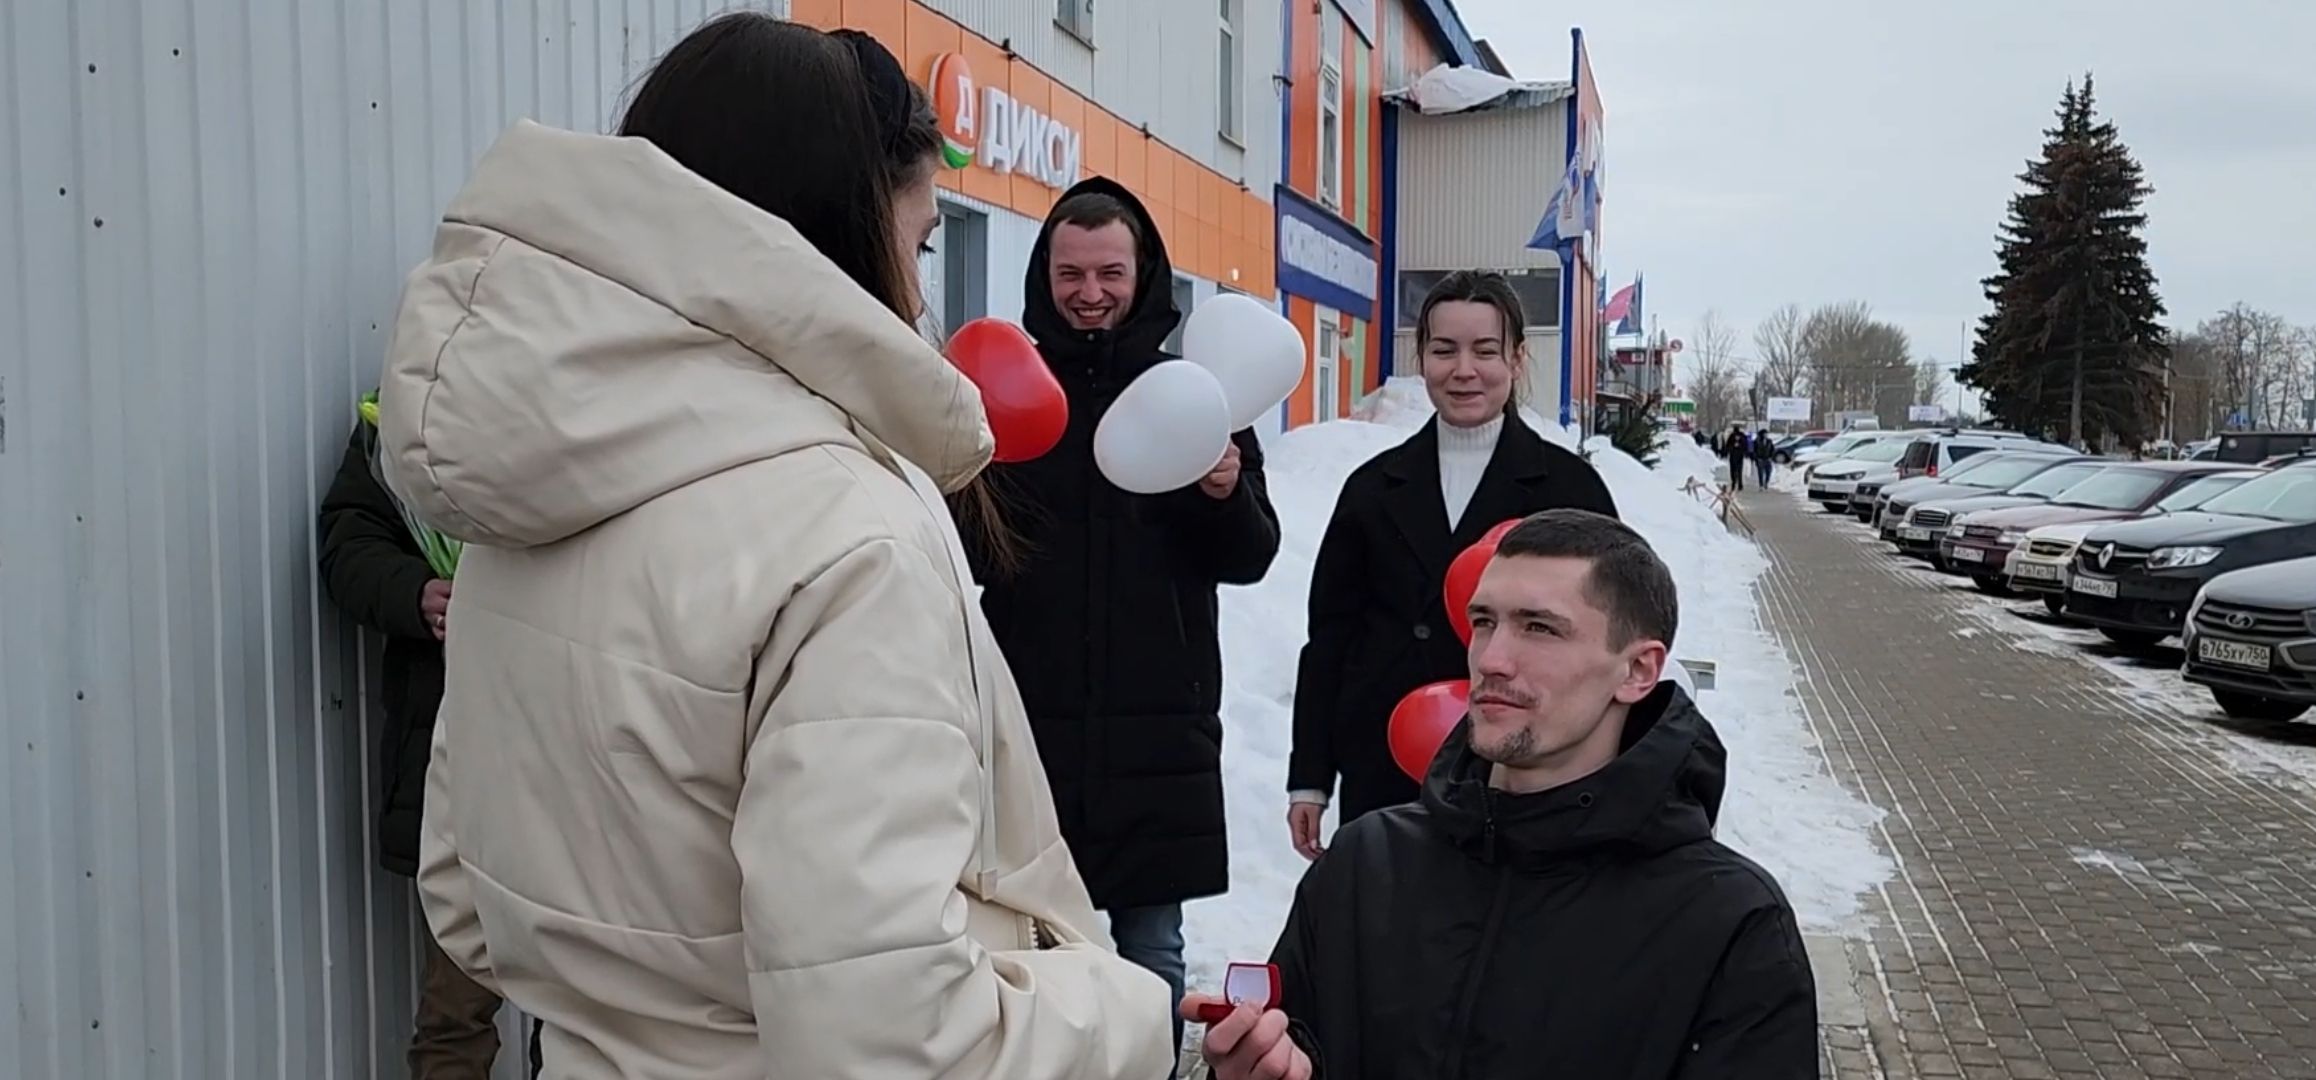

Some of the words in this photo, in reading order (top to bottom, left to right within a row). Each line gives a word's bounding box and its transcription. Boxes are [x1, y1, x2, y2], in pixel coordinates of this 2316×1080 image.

[955, 75, 975, 139] Д
[980, 86, 1080, 190] ДИКСИ
[2246, 646, 2268, 661] 750
